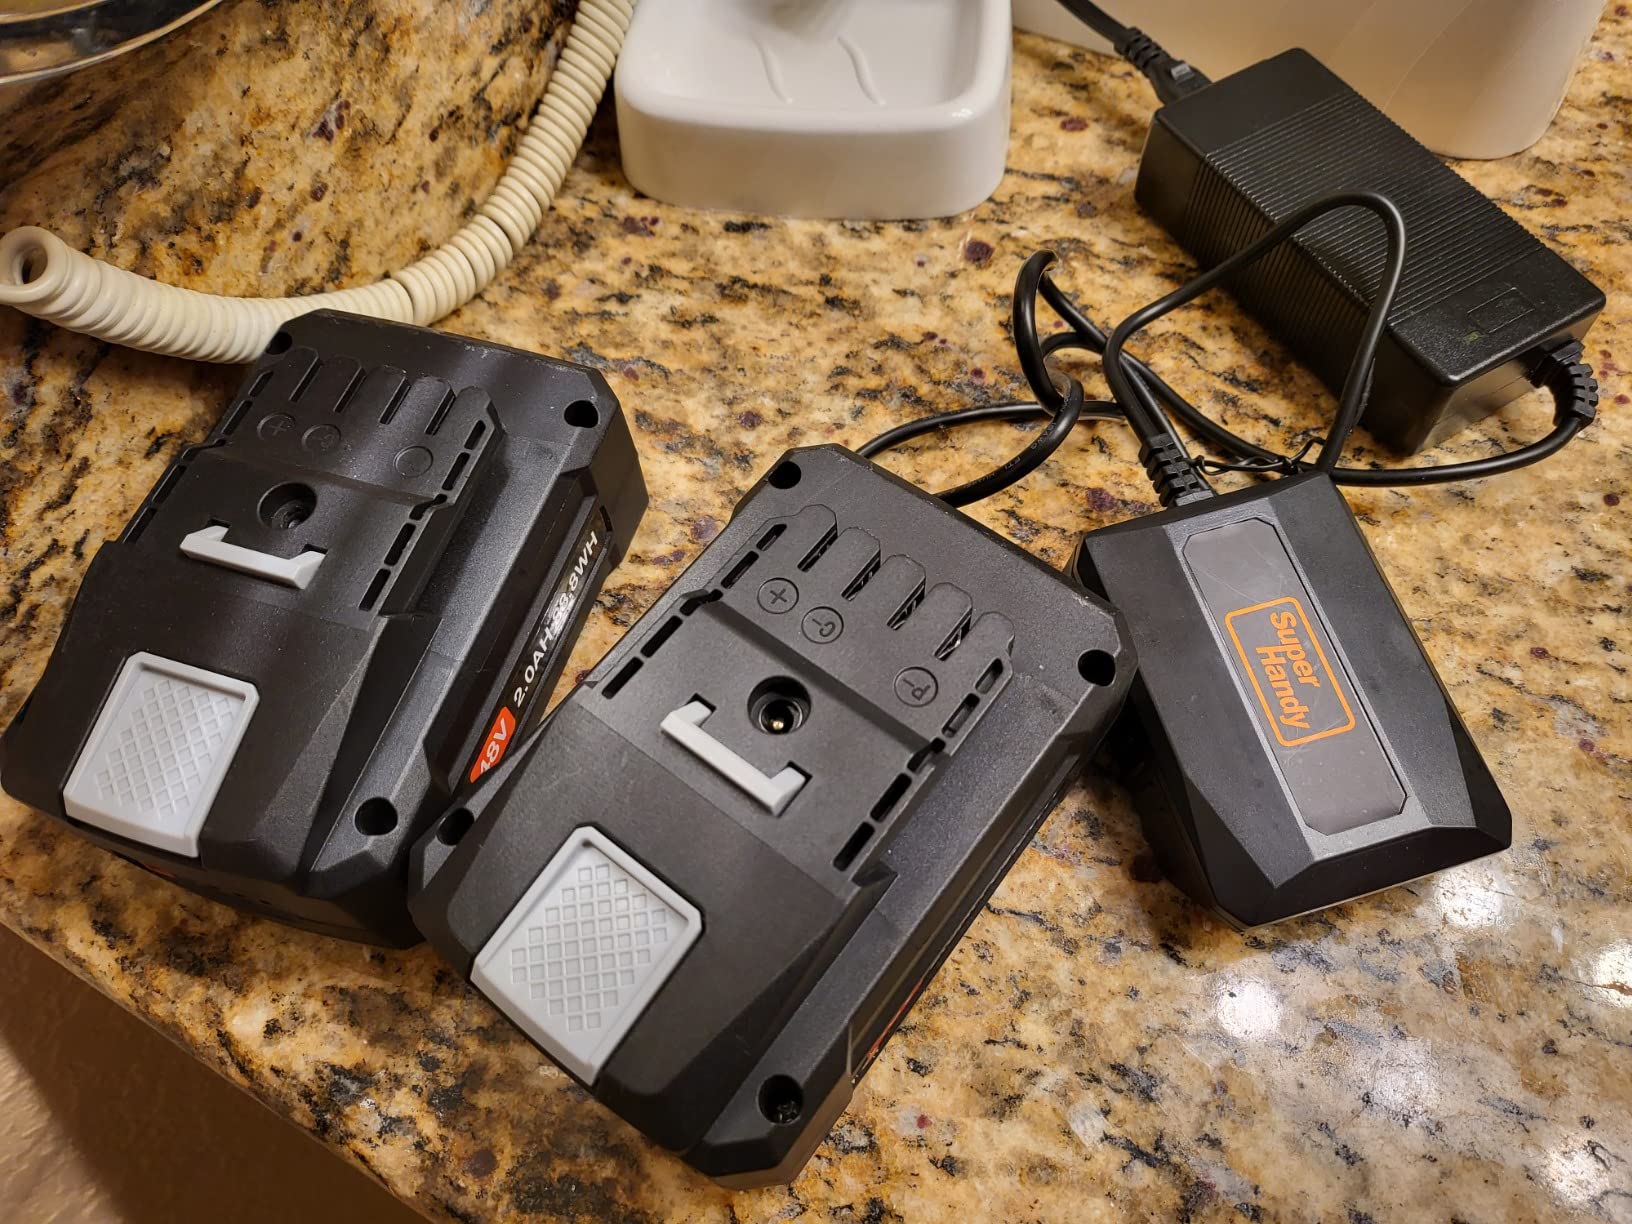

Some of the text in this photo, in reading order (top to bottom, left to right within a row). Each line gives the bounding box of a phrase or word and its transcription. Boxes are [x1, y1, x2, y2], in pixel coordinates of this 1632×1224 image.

[513, 626, 553, 708] 2.0AH
[1255, 645, 1311, 729] Handy
[1269, 611, 1321, 688] Super
